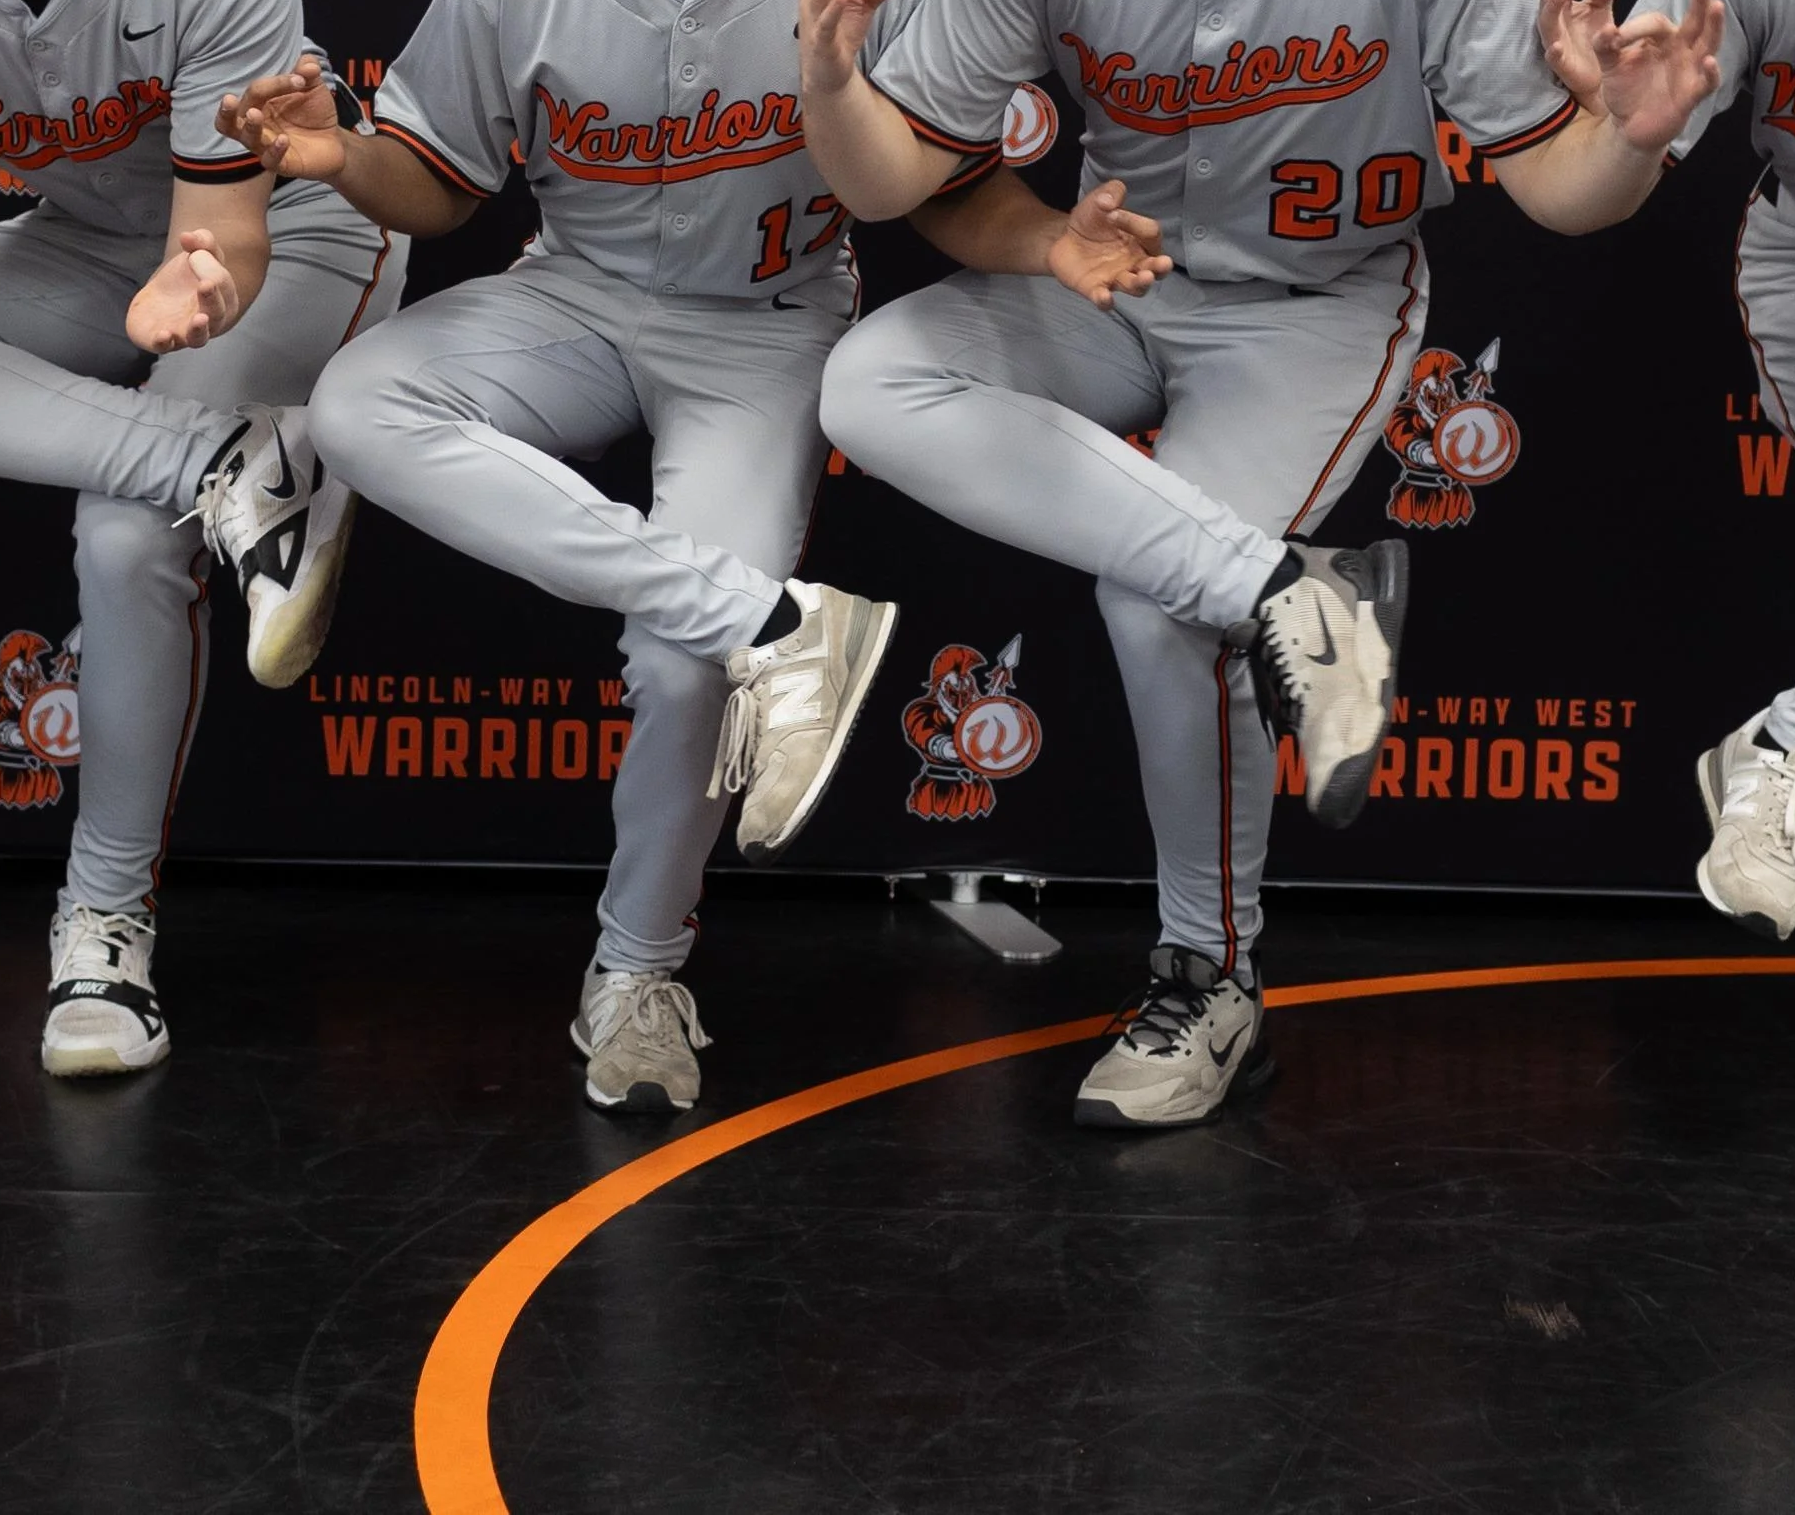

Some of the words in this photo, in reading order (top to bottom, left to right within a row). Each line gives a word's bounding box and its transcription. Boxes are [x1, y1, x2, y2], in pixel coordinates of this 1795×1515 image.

[1059, 25, 1389, 118] Warriors
[537, 82, 805, 166] Warrior
[1268, 150, 1427, 241] 20
[311, 676, 571, 704] LINCOLN-WAY
[1537, 699, 1636, 727] WEST
[323, 716, 632, 779] WARRIOR
[69, 980, 110, 995] NIKE
